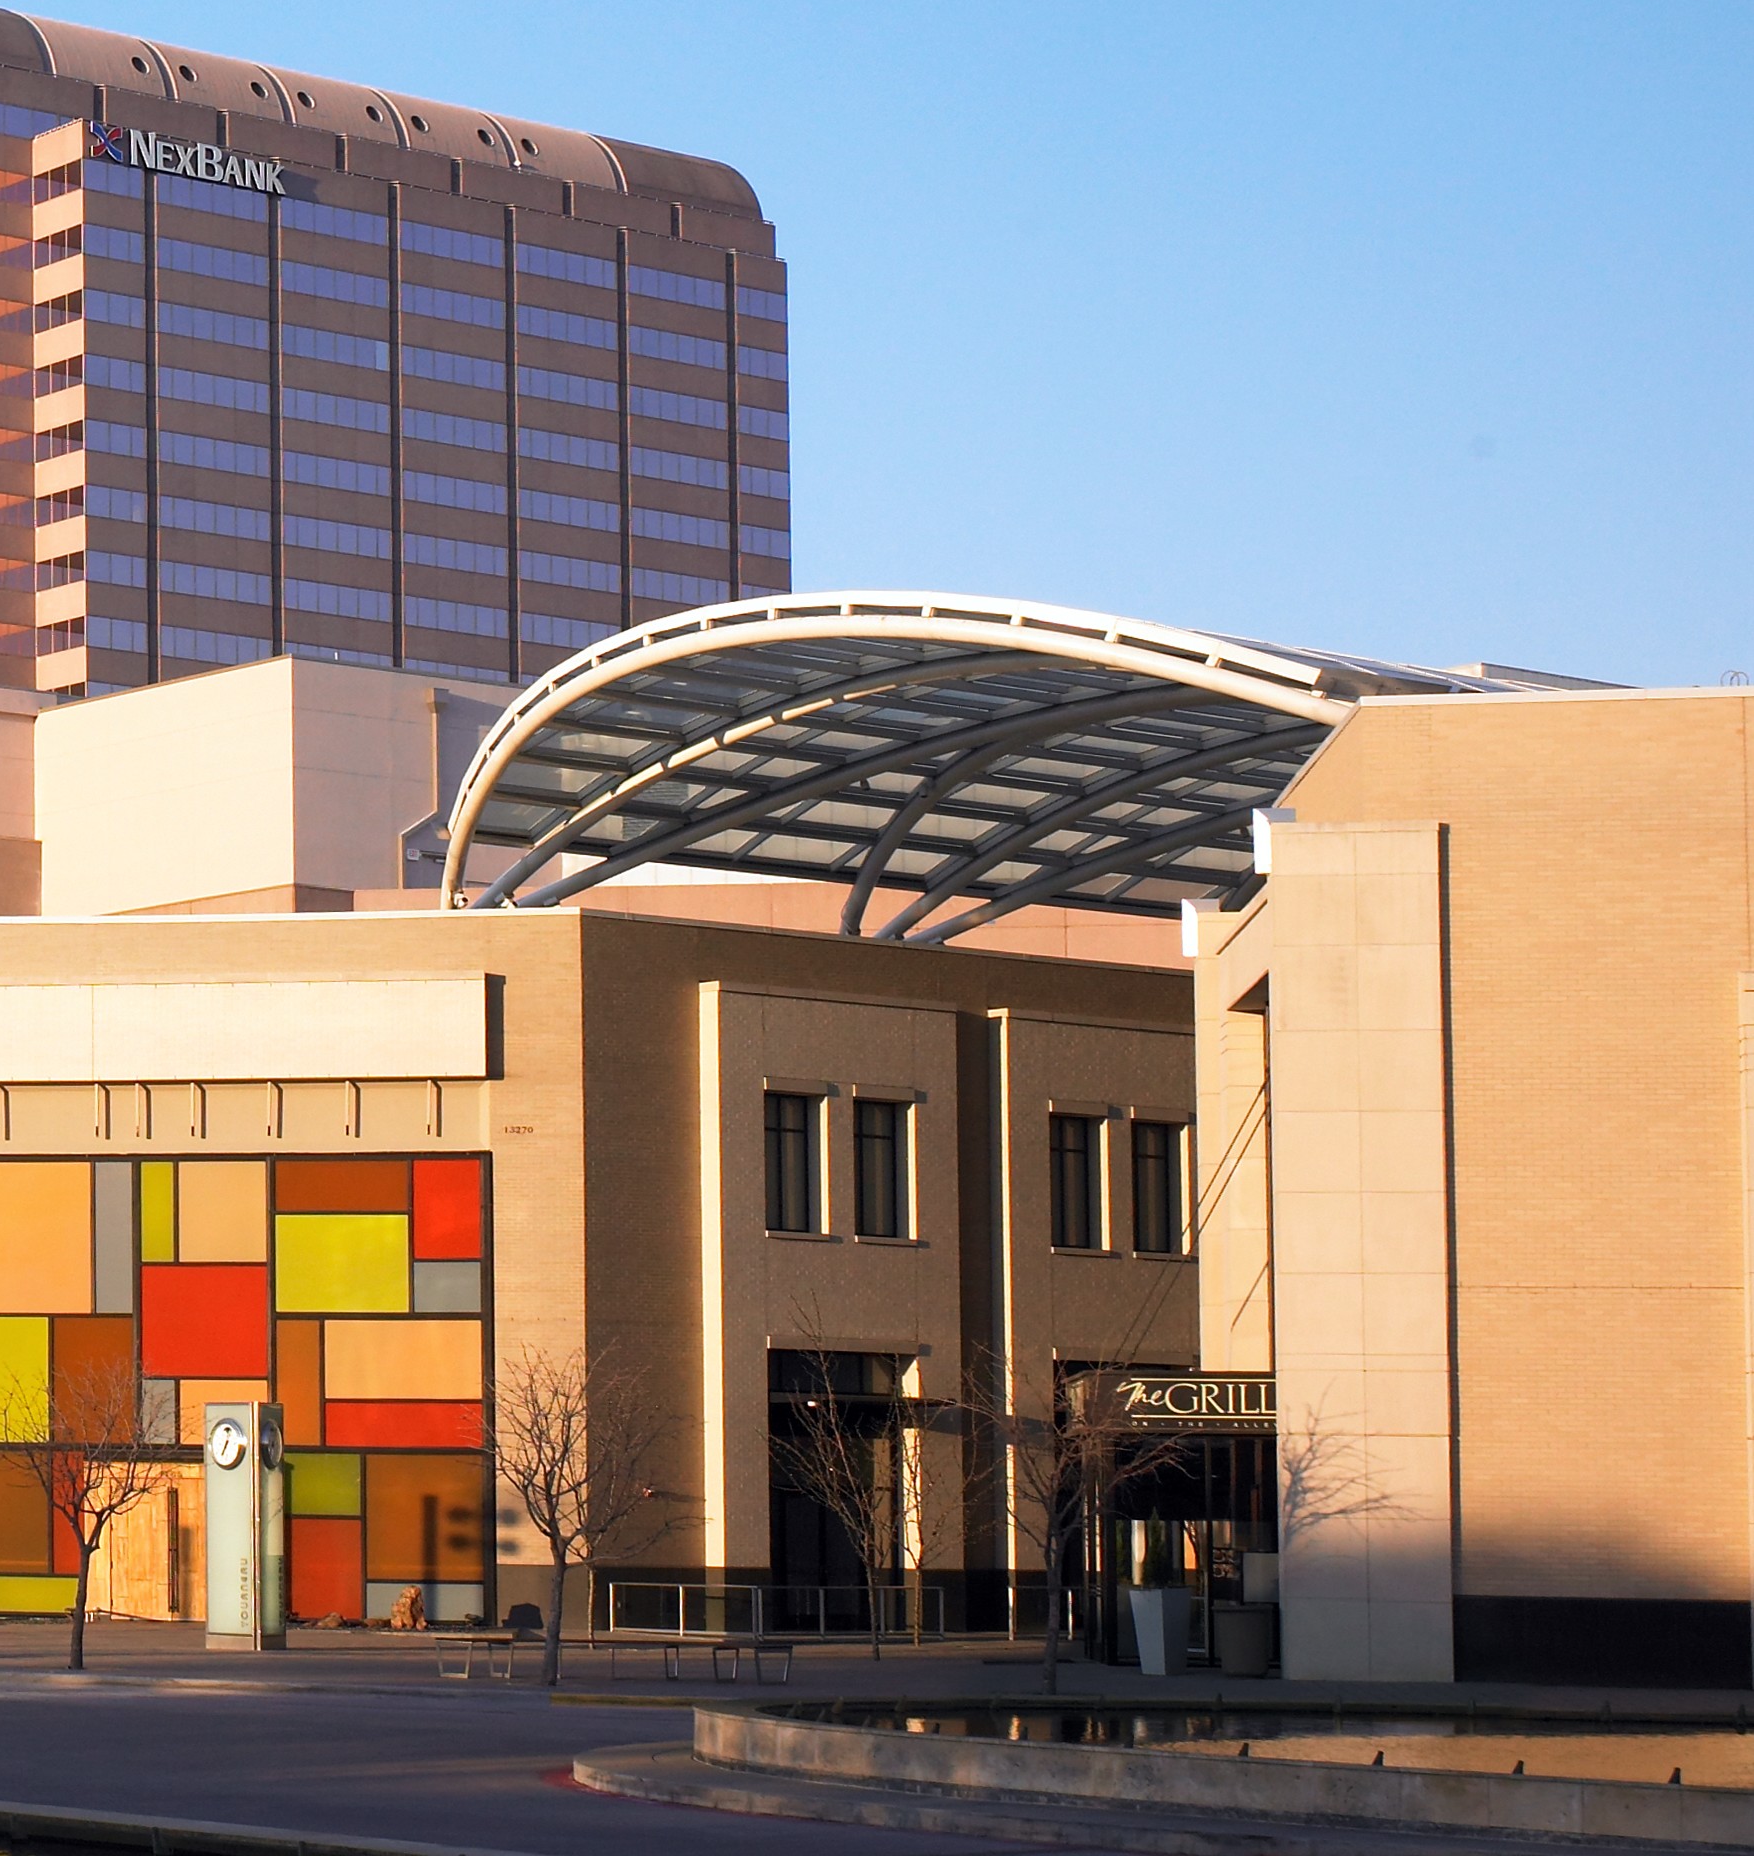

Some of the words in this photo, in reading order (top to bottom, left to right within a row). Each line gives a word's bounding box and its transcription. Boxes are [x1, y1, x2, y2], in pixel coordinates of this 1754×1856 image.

[504, 1126, 534, 1134] 13270
[1116, 1381, 1166, 1411] The
[1164, 1382, 1277, 1415] GRILL
